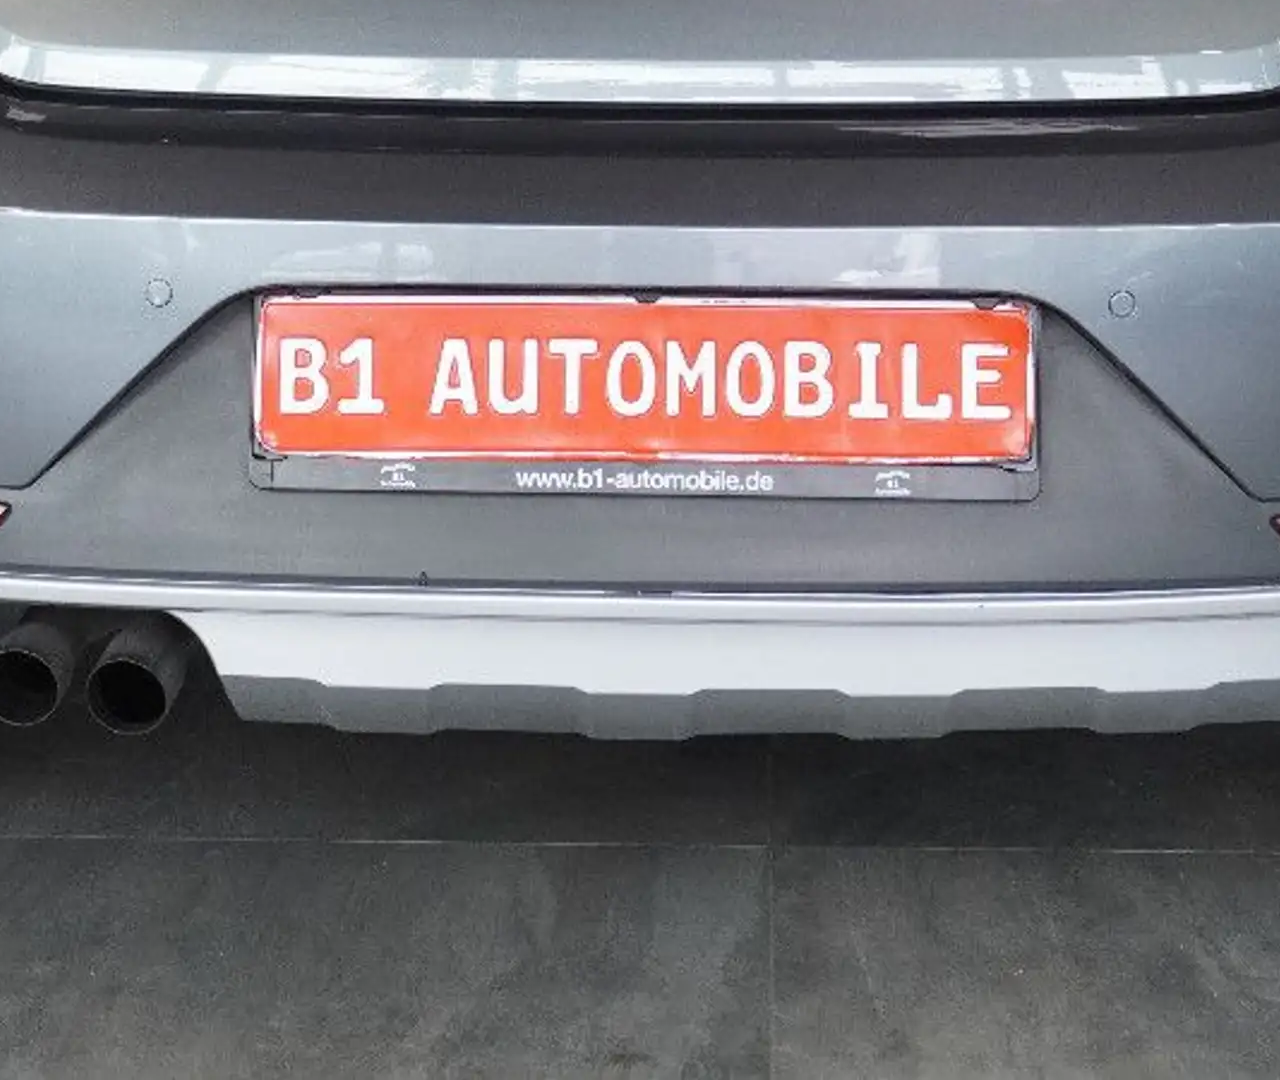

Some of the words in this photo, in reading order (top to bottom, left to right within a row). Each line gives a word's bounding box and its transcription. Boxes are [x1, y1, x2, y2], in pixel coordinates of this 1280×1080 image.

[278, 337, 385, 415] B1
[428, 337, 1012, 420] AUTOMOBILE
[515, 468, 775, 492] www.b1-automobile.de
